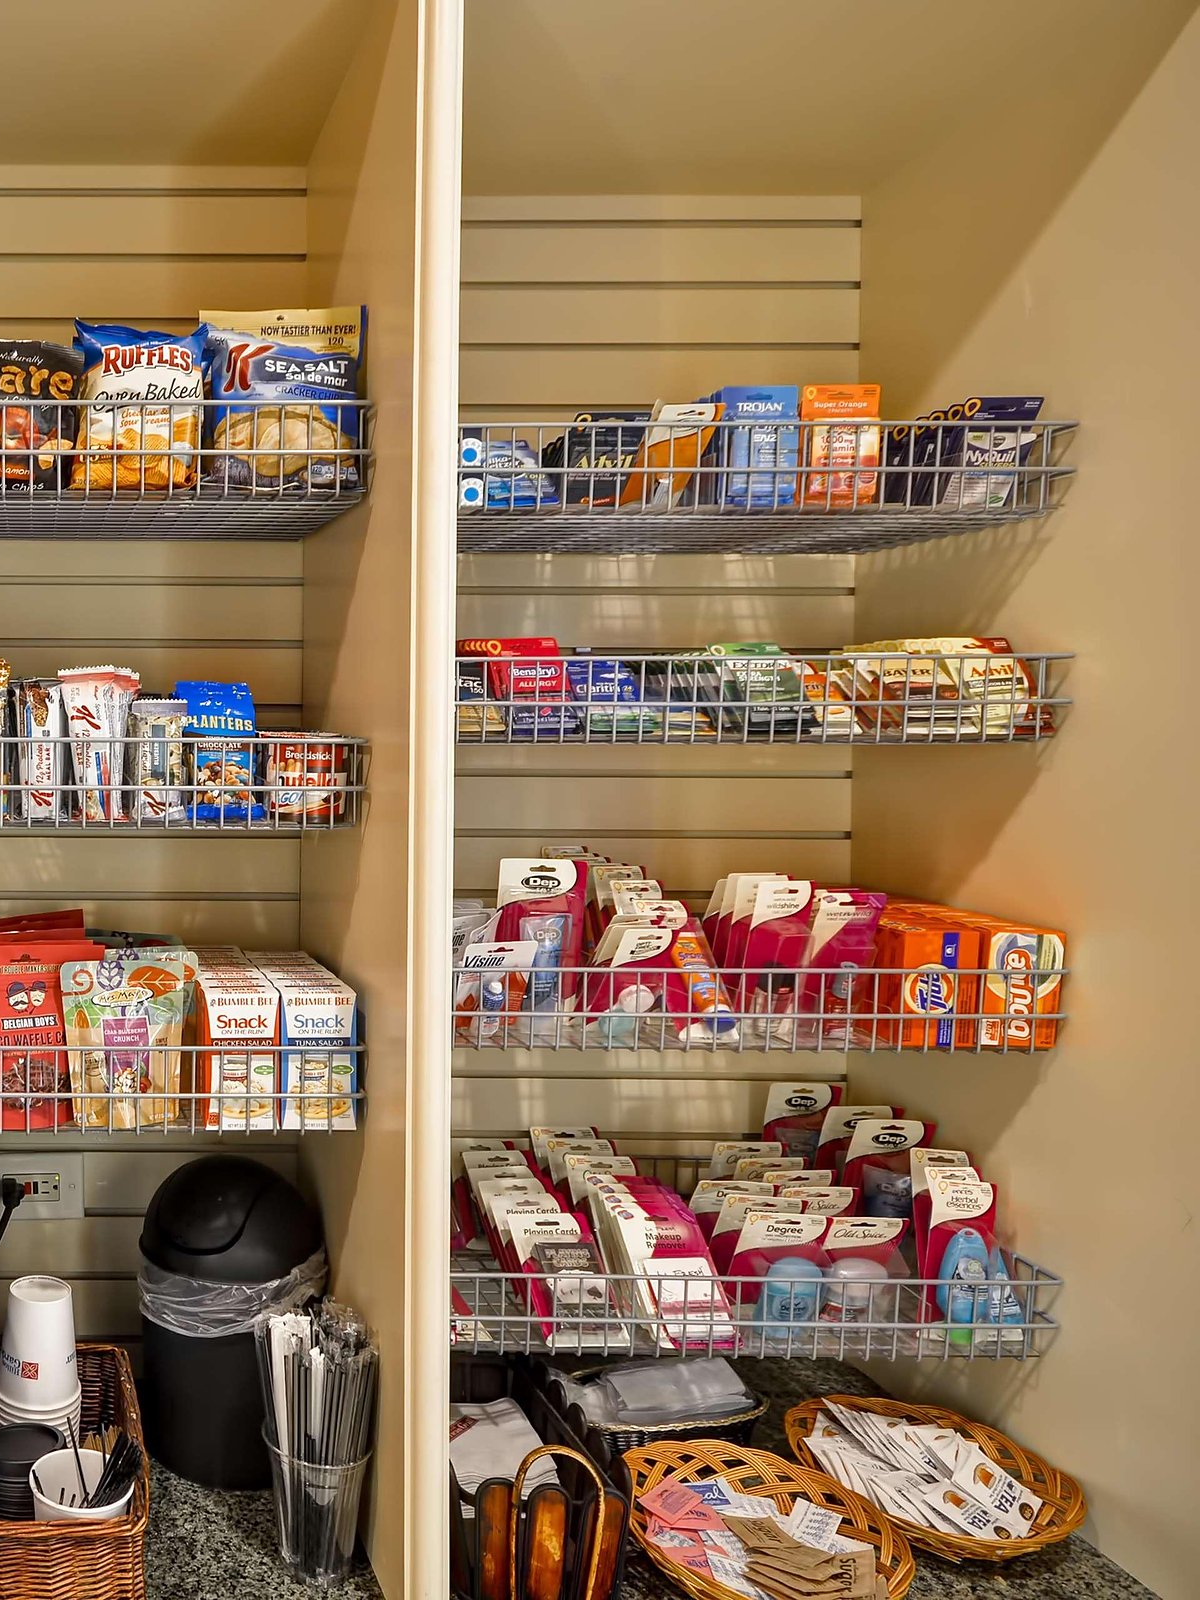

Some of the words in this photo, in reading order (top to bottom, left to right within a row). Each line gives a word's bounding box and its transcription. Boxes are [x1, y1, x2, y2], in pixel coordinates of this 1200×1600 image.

[260, 326, 280, 336] NOW
[281, 326, 310, 336] TASTIER
[311, 325, 332, 335] THAN
[334, 324, 357, 335] EVER!
[327, 336, 344, 346] 120
[102, 344, 192, 375] RUFFLES
[223, 343, 275, 393] K
[264, 359, 301, 373] SEA
[304, 360, 349, 374] SALT
[307, 371, 322, 382] de
[323, 376, 348, 387] mar
[146, 378, 201, 401] Baked
[275, 386, 317, 397] CRACKER
[736, 402, 783, 412] TROJAN
[813, 401, 837, 409] Super
[839, 401, 868, 409] Orange
[182, 714, 253, 731] PLANTERS
[529, 877, 560, 888] Dep
[767, 902, 800, 910] wildshine
[464, 954, 505, 968] Visine
[2, 966, 25, 975] TROUBLE
[218, 997, 256, 1007] BUMBLE
[257, 996, 275, 1006] BEE
[295, 997, 333, 1007] BUMBLE
[334, 996, 353, 1006] BEE
[3, 1017, 34, 1030] BELGIAN
[34, 1016, 55, 1027] BOYS
[216, 1014, 268, 1029] Snack
[293, 1014, 345, 1029] Snack
[13, 1034, 53, 1046] WAFFLE
[113, 1034, 140, 1043] CRUNCH
[213, 1039, 247, 1047] CHICKEN
[247, 1039, 273, 1047] SALAD
[295, 1039, 316, 1047] TUNA
[317, 1039, 344, 1047] SALAD
[791, 1097, 815, 1107] Dep
[878, 1134, 906, 1145] Dep
[950, 1196, 979, 1204] Herbal
[554, 1227, 578, 1236] Cards
[766, 1224, 804, 1237] Degree
[833, 1228, 861, 1240] Old
[644, 1232, 682, 1242] Makeup
[646, 1240, 686, 1250] Remover
